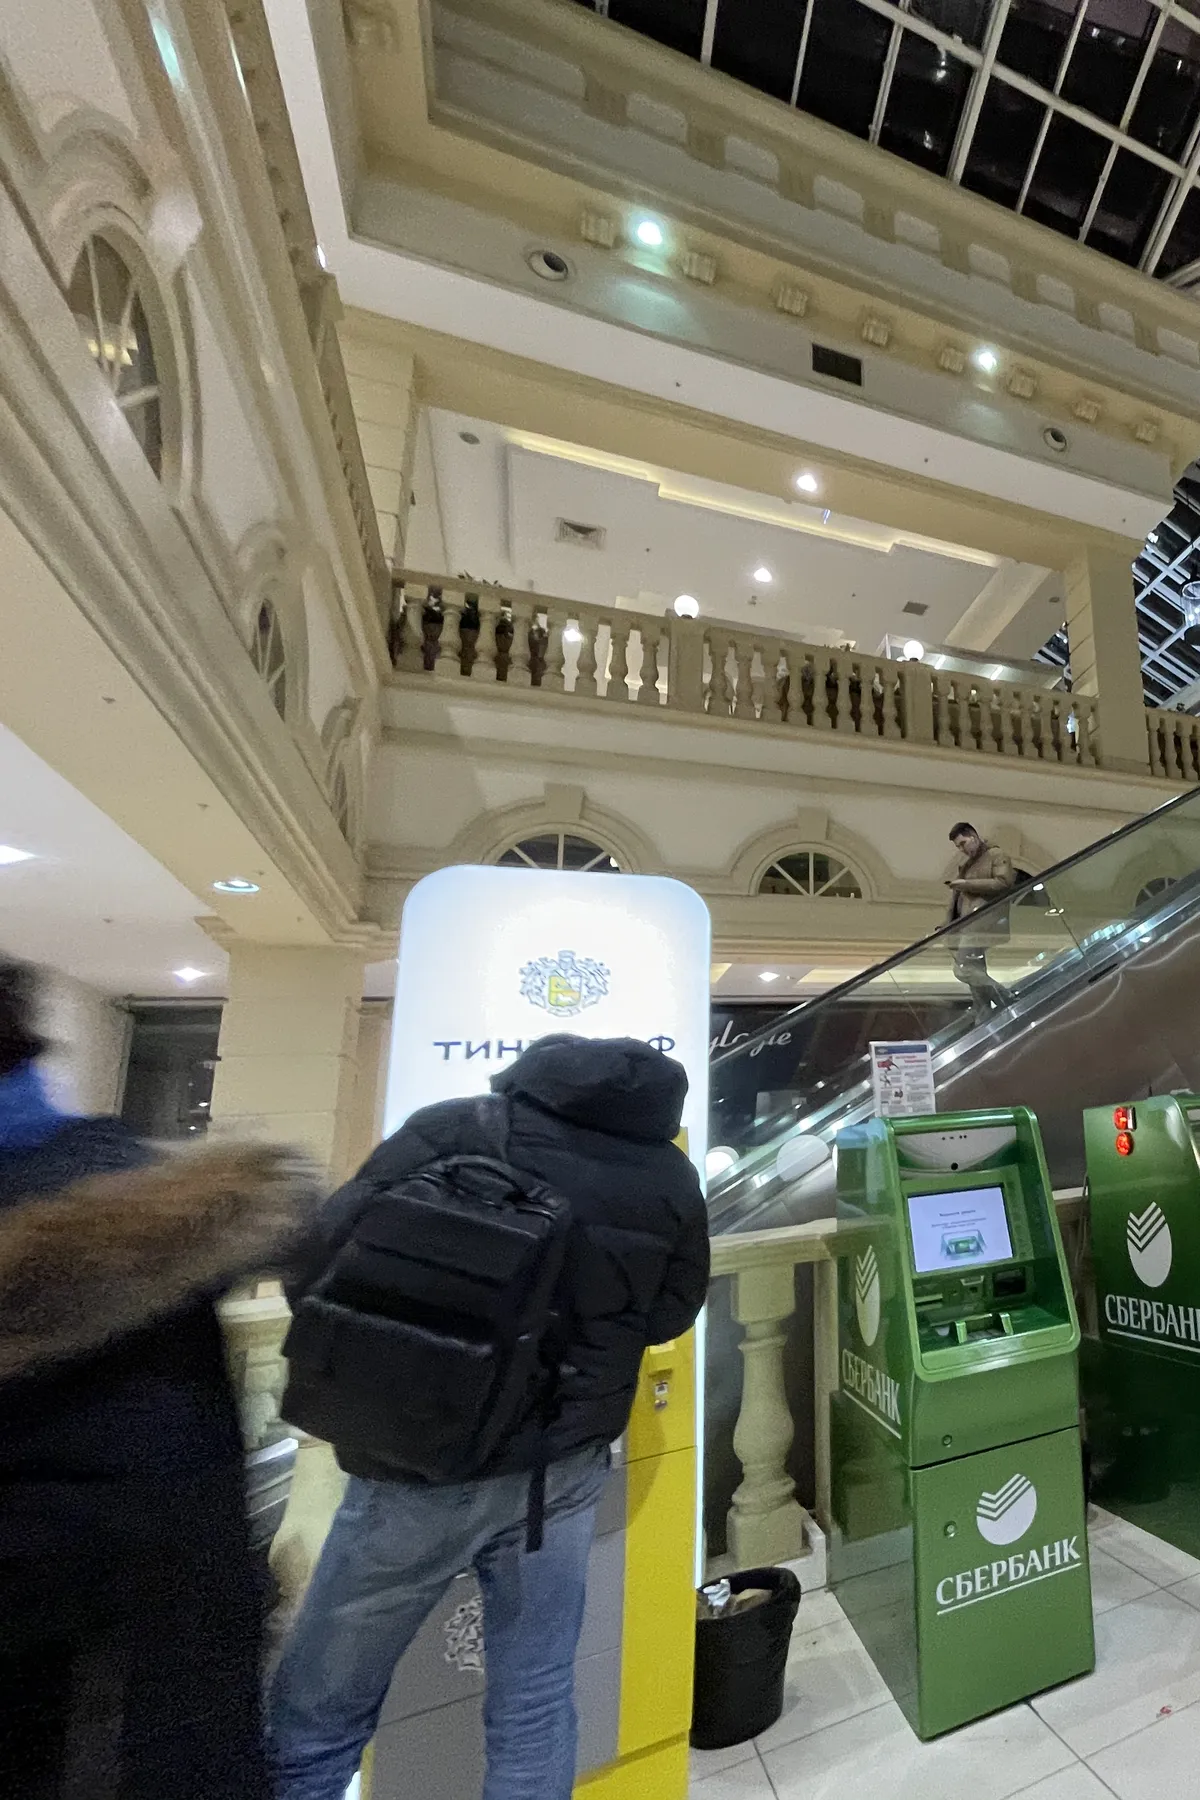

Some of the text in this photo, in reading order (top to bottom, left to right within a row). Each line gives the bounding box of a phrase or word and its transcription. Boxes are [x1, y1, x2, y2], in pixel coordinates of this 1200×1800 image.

[433, 1036, 676, 1060] ТИНФ
[842, 1349, 901, 1425] СБЕРБАНК
[936, 1536, 1081, 1605] СБЕРБАНК
